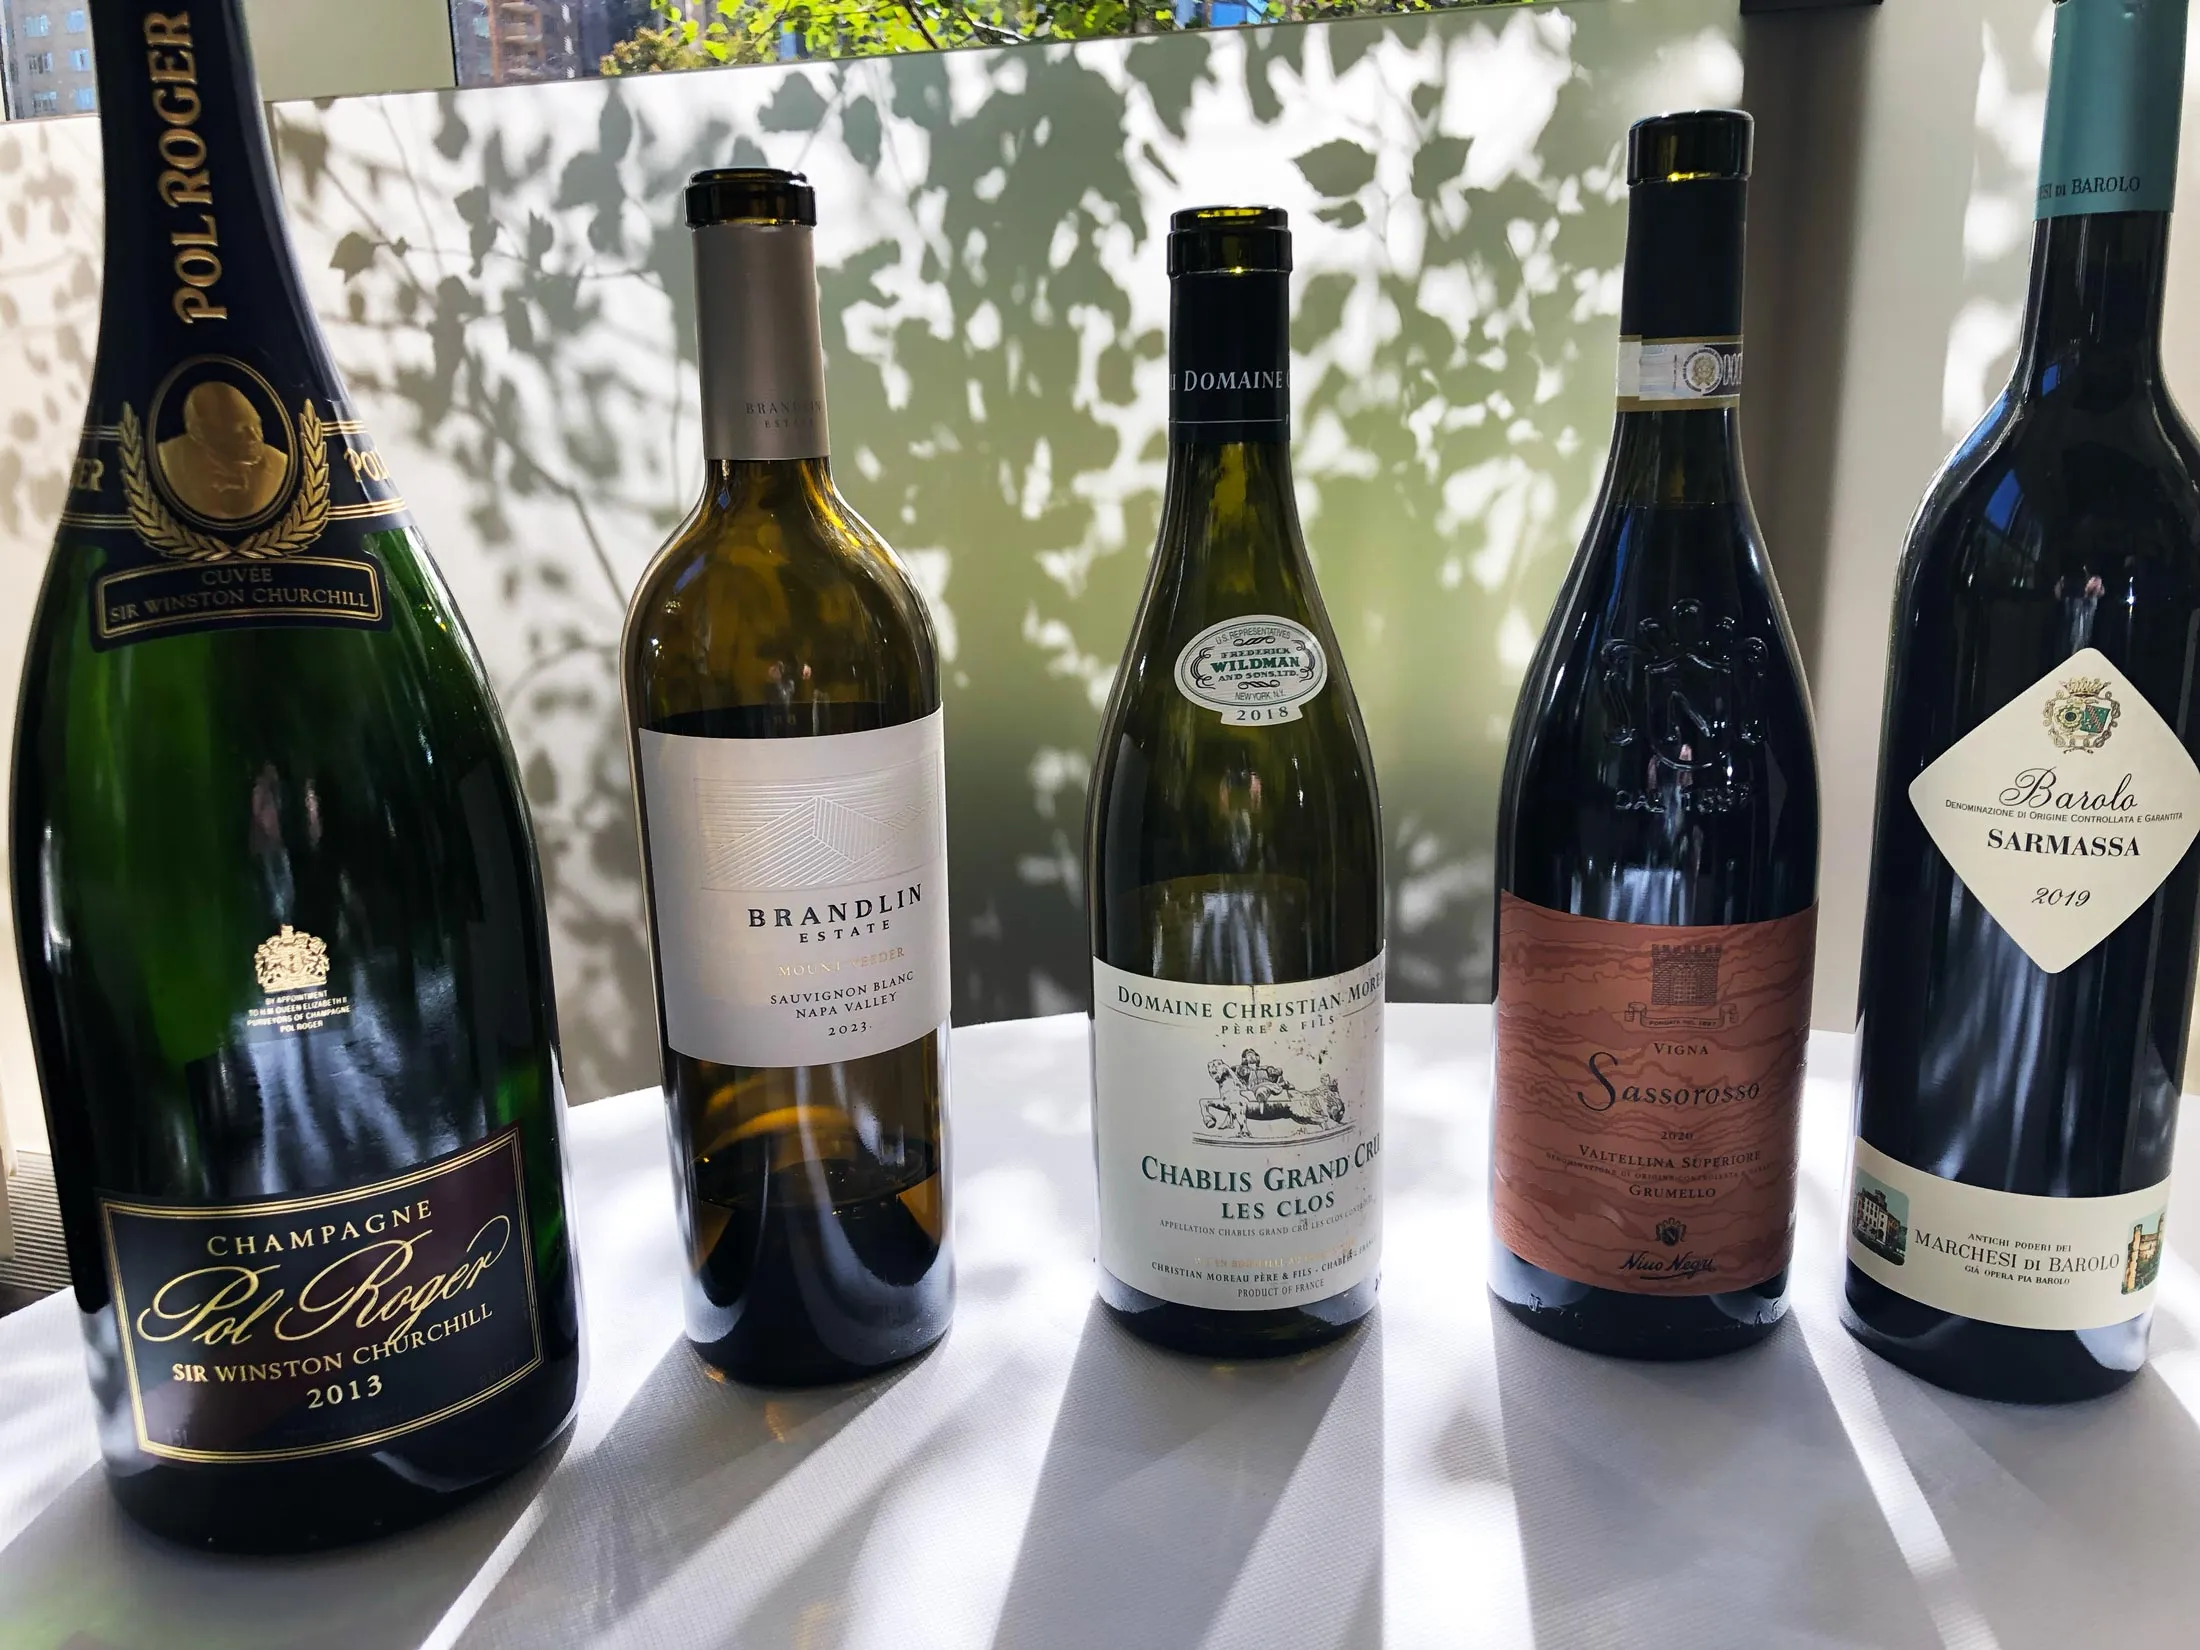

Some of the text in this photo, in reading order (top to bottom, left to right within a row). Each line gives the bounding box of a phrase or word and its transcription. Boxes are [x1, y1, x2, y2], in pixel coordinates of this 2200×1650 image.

[143, 10, 228, 325] POL ROGER
[2055, 184, 2066, 197] DI
[2071, 176, 2141, 195] BAROLO
[1184, 370, 1283, 392] DOMAINE
[109, 587, 370, 623] SIR WINSTON CHURCHILL
[1229, 627, 1291, 640] REPRESENTATIVES
[1221, 647, 1291, 659] FREDERICK
[1210, 656, 1300, 673] WILDMAN
[1218, 673, 1243, 681] AND
[1235, 691, 1251, 701] NEW
[1236, 706, 1289, 721] 2018
[1999, 766, 2138, 811] Barolo
[1945, 799, 2014, 818] DENOMINAZIONE
[2017, 810, 2027, 819] DI
[2029, 811, 2068, 822] ORIGINE
[2070, 814, 2134, 824] CONTROLLATA
[2137, 815, 2142, 823] E
[1987, 828, 2141, 857] SARMASSA
[748, 884, 923, 928] BRANDLIN
[2031, 888, 2091, 908] 2019
[800, 919, 890, 943] ESTATE
[776, 961, 841, 977] MOUNT
[276, 990, 328, 1004] APPOINTMENT
[770, 971, 914, 1005] SAUVIGNON BLANC
[275, 1004, 302, 1014] QUEEN
[303, 997, 342, 1010] ELIZABETH
[796, 992, 897, 1019] NAPA VALLEY
[1118, 985, 1212, 1018] DOMAINE
[1222, 993, 1341, 1019] CHRISTIAN
[246, 1005, 351, 1027] PURVEYORS OF CHAMPAGNE
[280, 1019, 324, 1033] POL ROGER
[1221, 1015, 1335, 1035] PÈRE & FILS
[1653, 1043, 1709, 1055] VIGNA
[1577, 1051, 1760, 1112] Sassorosso
[1660, 1131, 1694, 1141] 2020
[1141, 1133, 1380, 1193] CHABLIS GRAND CRU
[1579, 1144, 1675, 1169] VALTELLINA
[1682, 1150, 1761, 1169] SUPERIORE
[1629, 1183, 1716, 1199] GRUMELLO
[1222, 1191, 1334, 1220] LES CLOS
[206, 1199, 432, 1257] CHAMPAGNE
[1159, 1219, 1215, 1235] APPELLATION
[1218, 1228, 1256, 1237] CHABLIS
[1259, 1227, 1289, 1236] GRAND
[1311, 1220, 1324, 1230] LES
[1914, 1229, 2120, 1273] MARCHESI DI BAROLO
[1968, 1233, 2072, 1253] ANTICHI PODERI DEI
[136, 1214, 511, 1347] Pol Roger
[1151, 1261, 1203, 1280] CHRISTIAN
[1206, 1272, 1249, 1283] MOREAU
[1254, 1271, 1279, 1282] PÈRE
[1282, 1272, 1288, 1280] &
[1293, 1267, 1312, 1279] FILS
[1984, 1269, 2014, 1281] OPERA
[2017, 1274, 2033, 1284] PIA
[2035, 1276, 2071, 1286] BAROLO
[1238, 1279, 1325, 1298] PRODUCT OF FRANCE
[172, 1303, 494, 1383] SIR WINSTON CHURCHILL
[306, 1374, 384, 1409] 2013
